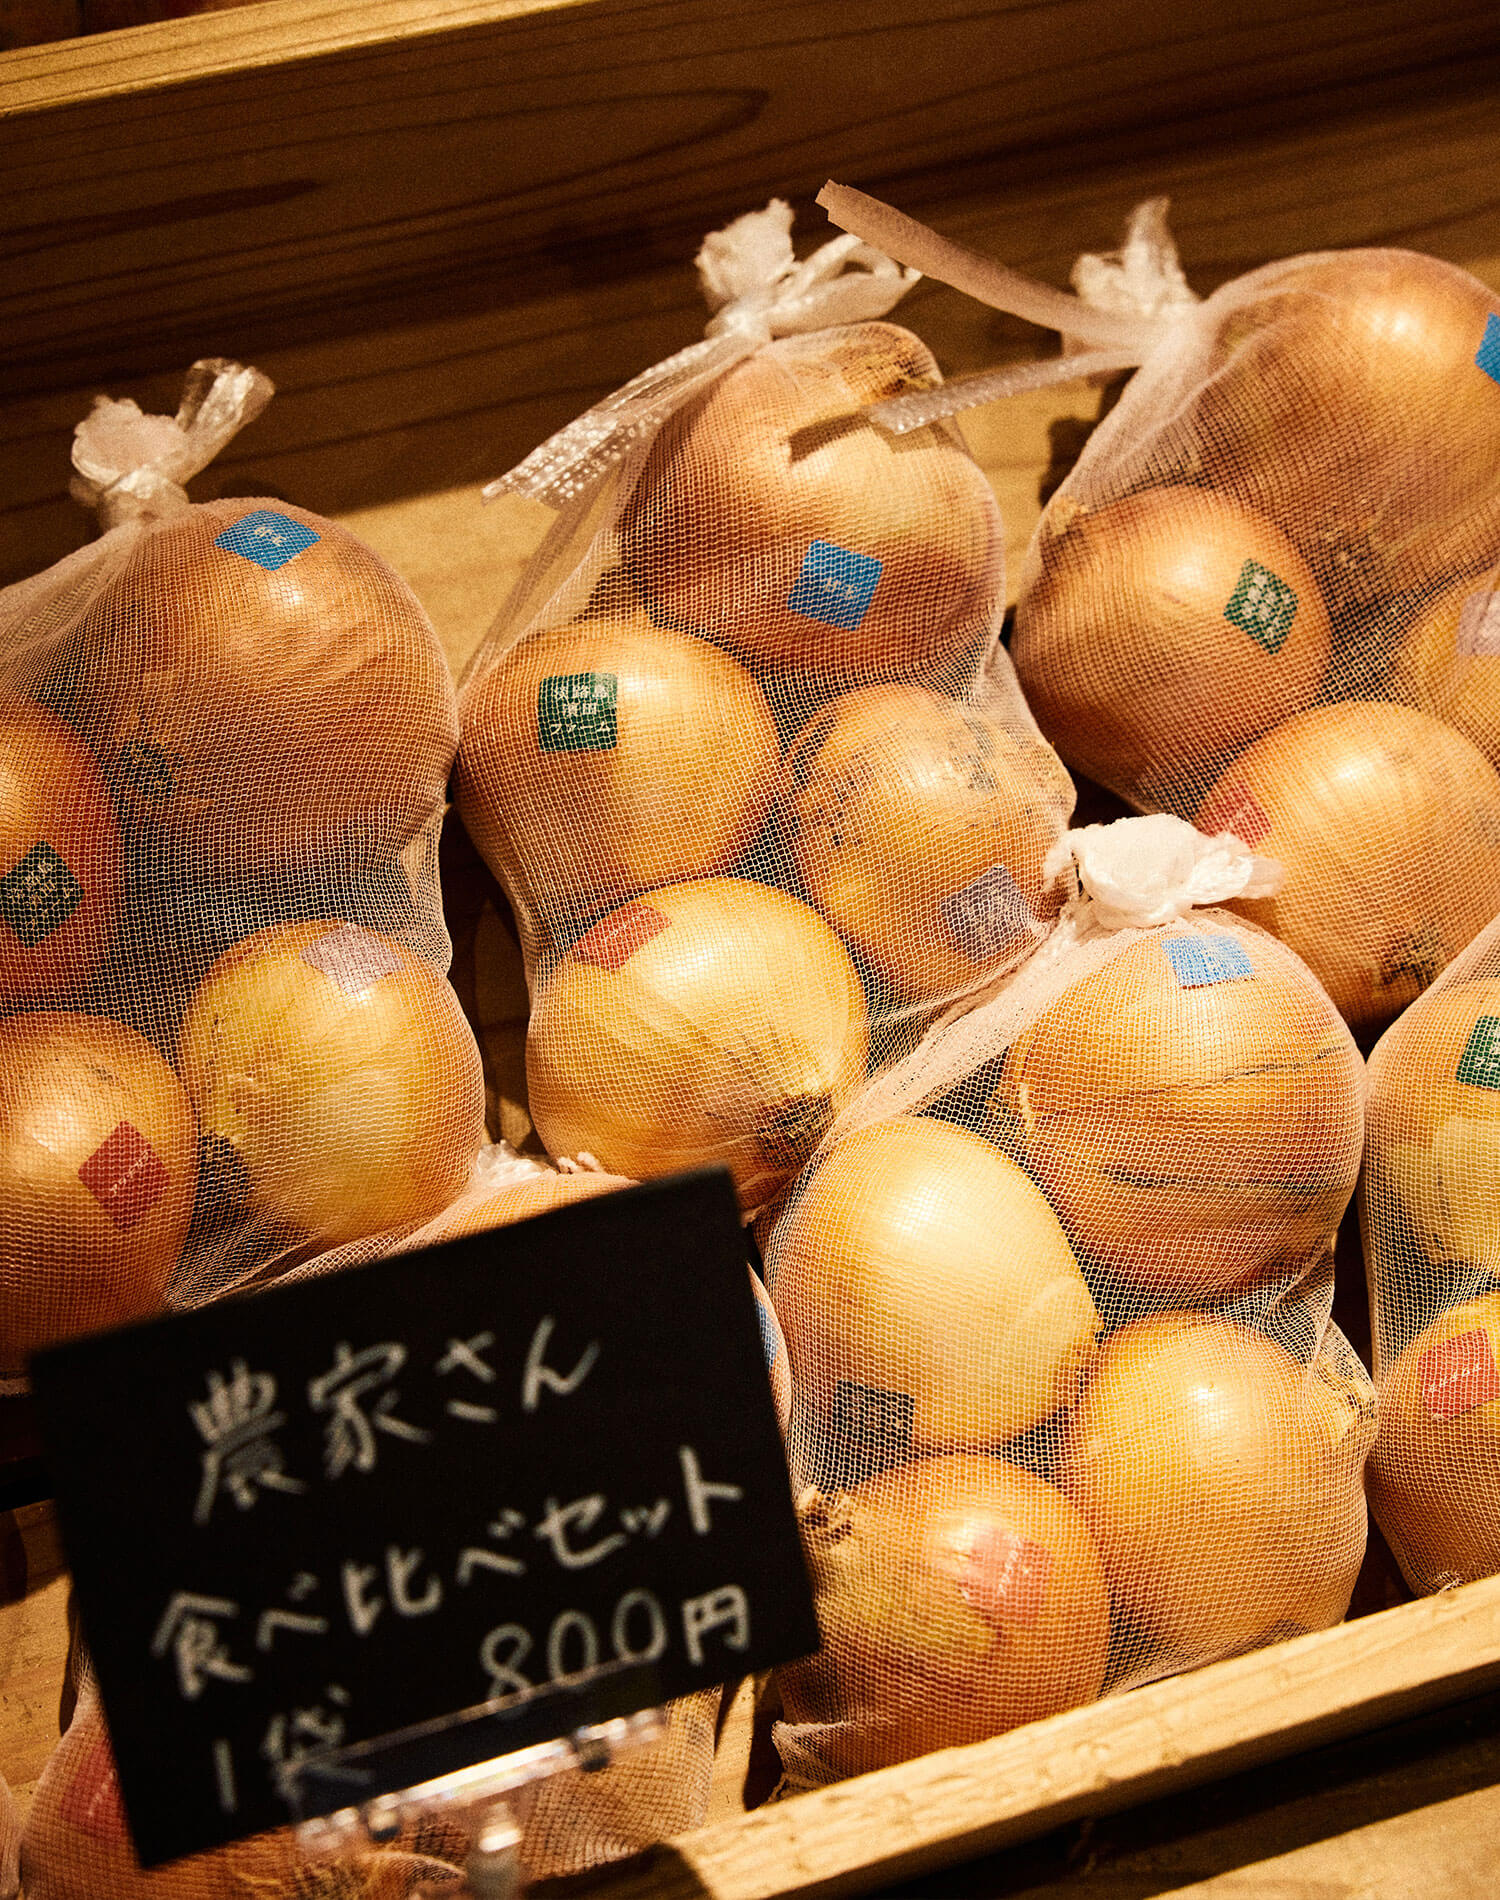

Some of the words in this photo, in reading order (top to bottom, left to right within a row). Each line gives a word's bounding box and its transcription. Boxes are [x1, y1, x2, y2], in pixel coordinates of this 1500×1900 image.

[189, 1314, 600, 1524] 農家さん
[151, 1444, 744, 1698] 食べ比べセット
[480, 1583, 749, 1710] 800円
